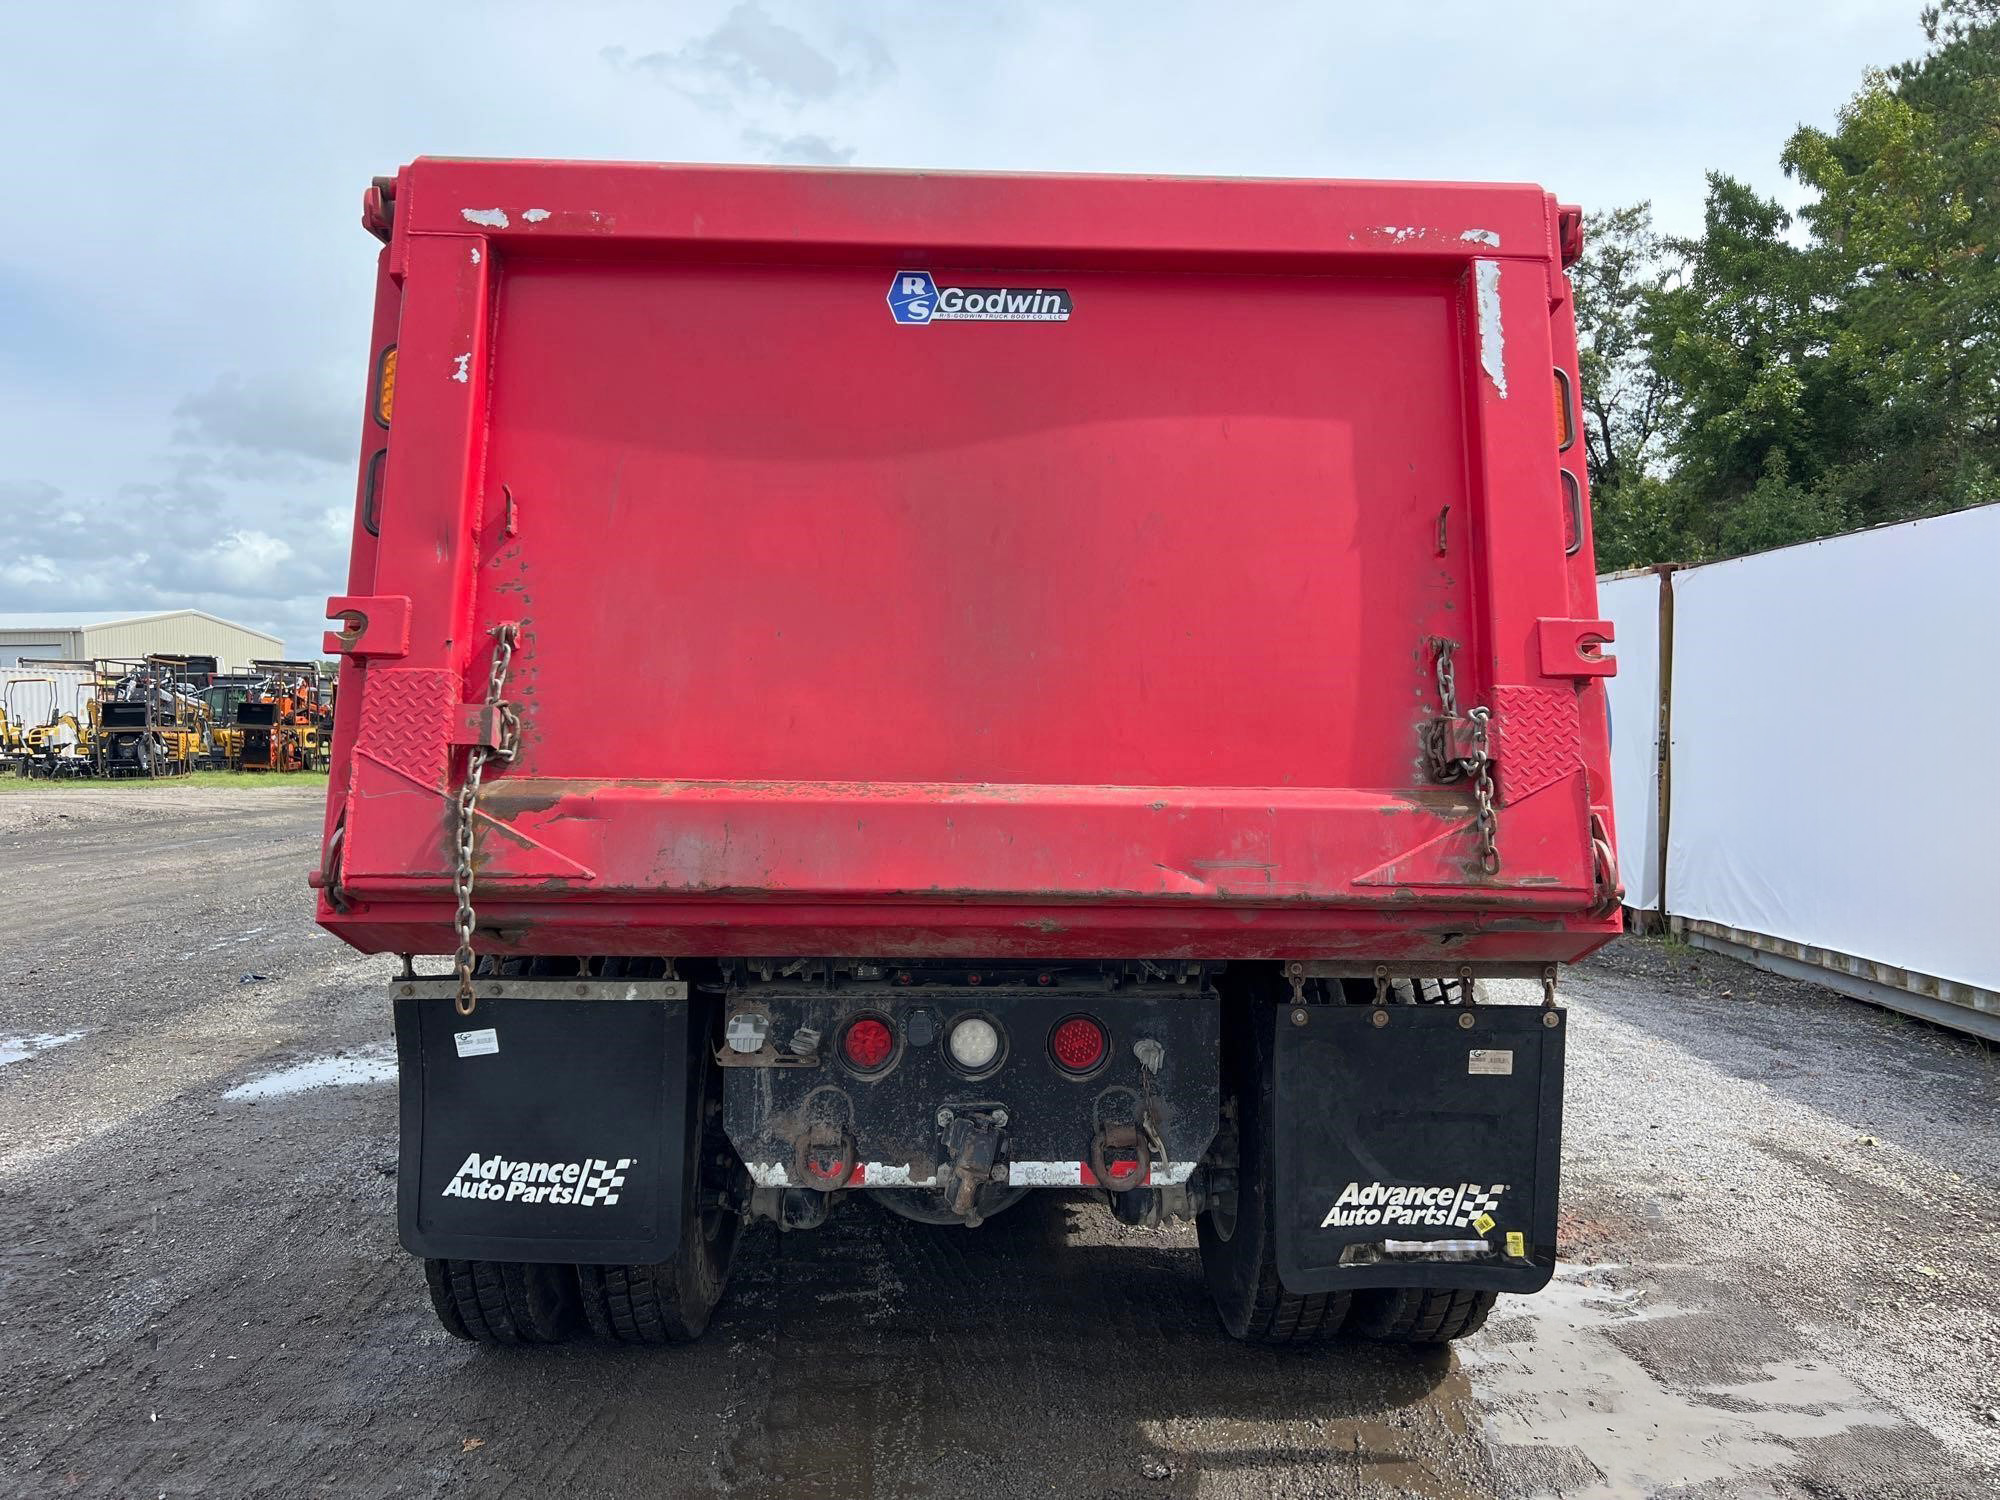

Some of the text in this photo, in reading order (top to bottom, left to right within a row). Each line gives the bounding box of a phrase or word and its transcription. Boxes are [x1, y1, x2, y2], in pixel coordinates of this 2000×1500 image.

[902, 277, 926, 295] R
[907, 300, 930, 320] S
[940, 287, 1061, 313] Godwin
[455, 1152, 580, 1183] Advance
[442, 1177, 574, 1204] Auto Parts
[1334, 1182, 1455, 1207] Advance
[1320, 1205, 1448, 1228] Auto Parts
